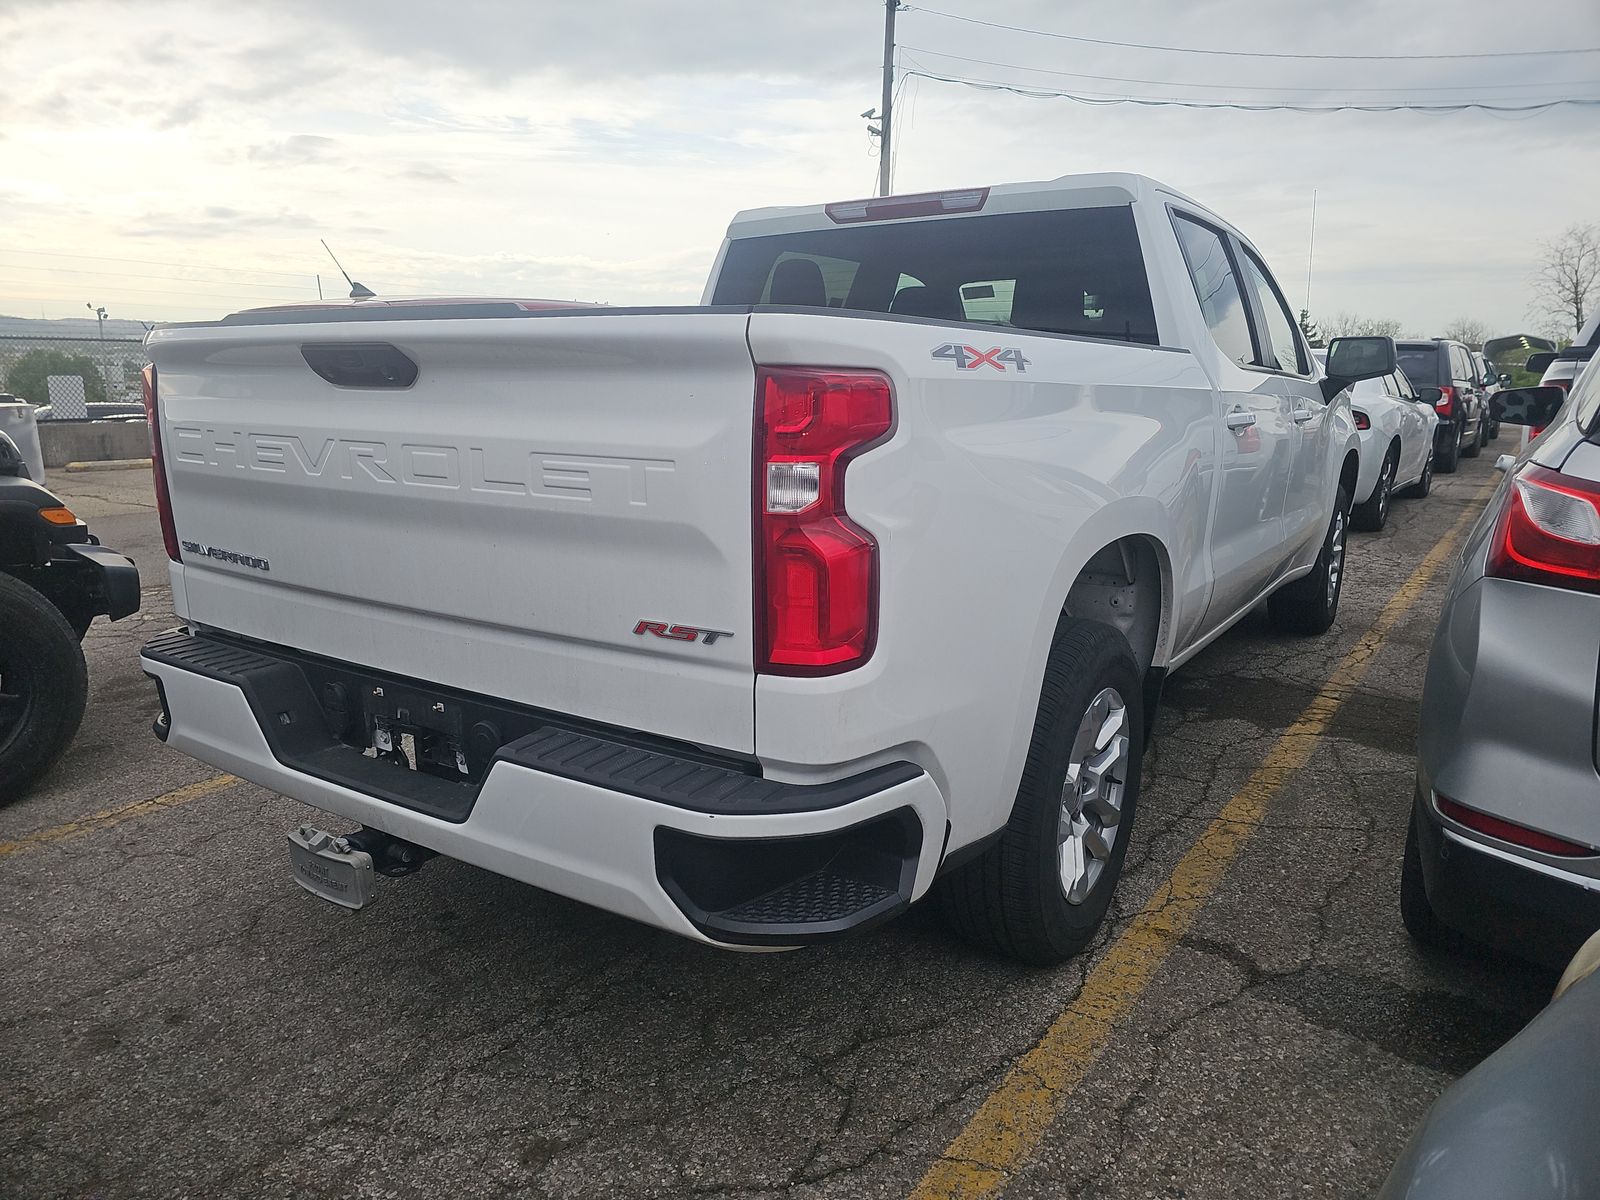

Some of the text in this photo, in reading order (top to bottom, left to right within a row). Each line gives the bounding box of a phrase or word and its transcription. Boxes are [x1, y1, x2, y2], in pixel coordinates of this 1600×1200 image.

[173, 426, 676, 506] CHEVROLET
[181, 540, 270, 571] SILVERADO
[632, 618, 735, 646] RST
